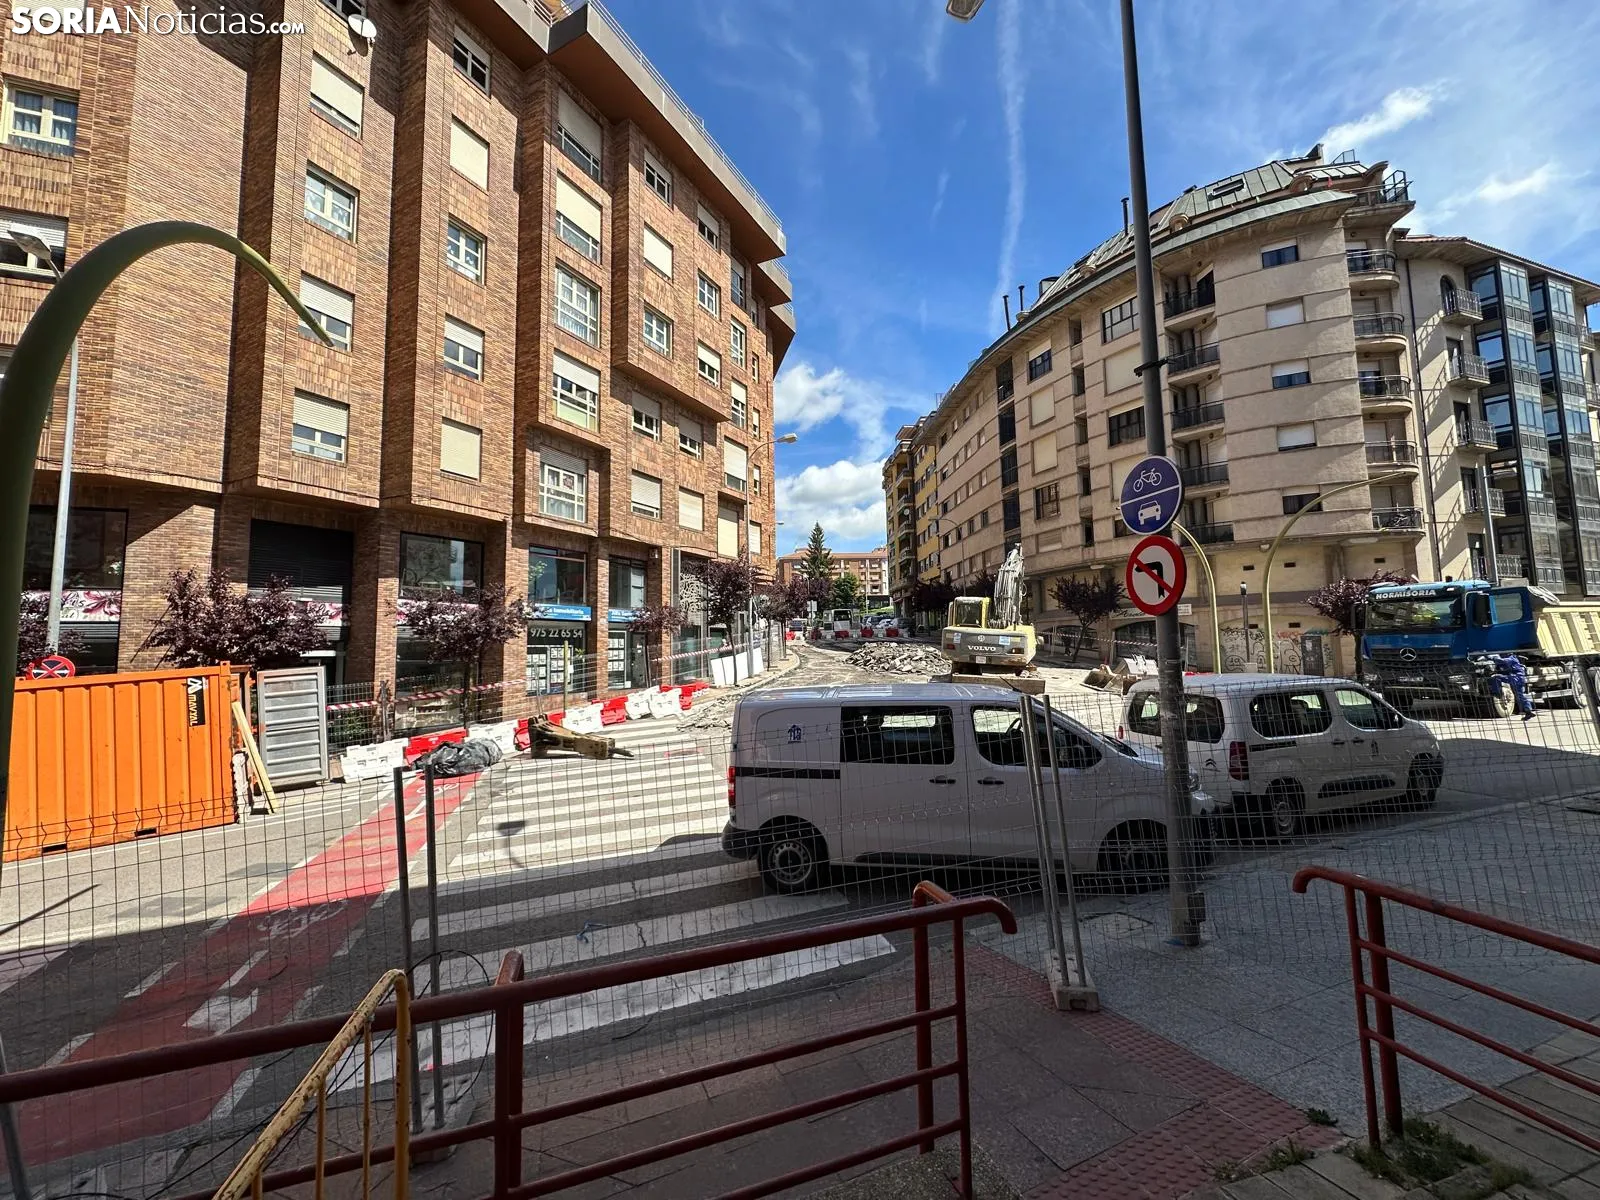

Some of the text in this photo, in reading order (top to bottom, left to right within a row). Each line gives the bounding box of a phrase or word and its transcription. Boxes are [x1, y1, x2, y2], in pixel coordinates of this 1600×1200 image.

[1375, 589, 1437, 600] HORMISORIA
[530, 627, 583, 639] 975 22 65 54
[967, 644, 997, 652] VOLVO
